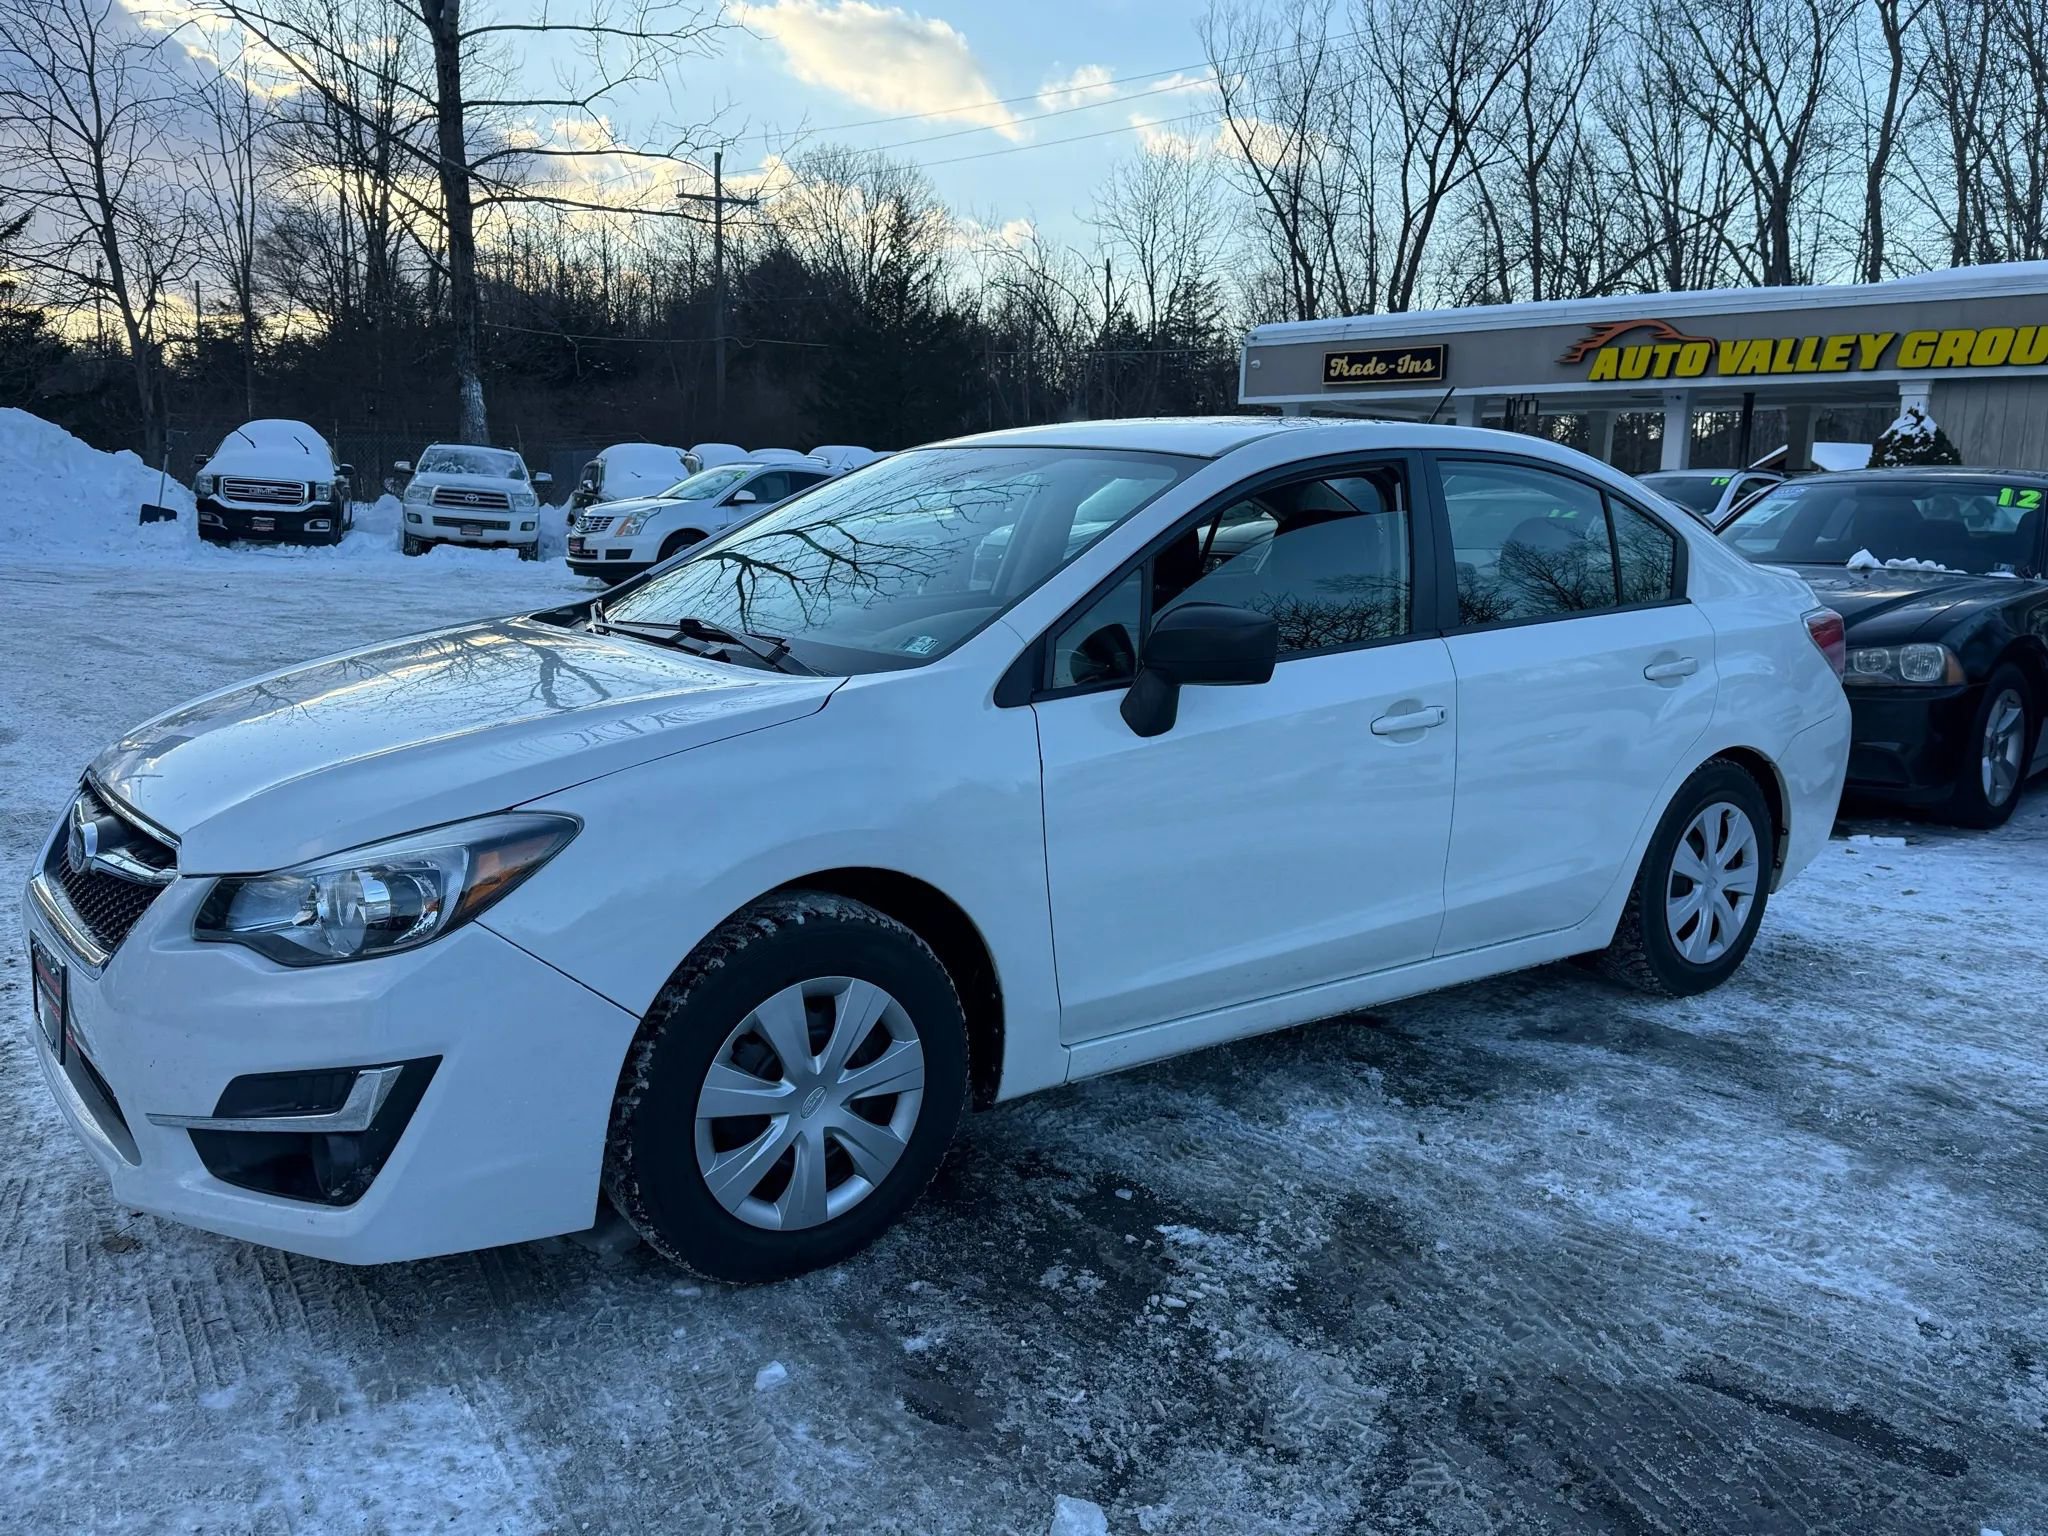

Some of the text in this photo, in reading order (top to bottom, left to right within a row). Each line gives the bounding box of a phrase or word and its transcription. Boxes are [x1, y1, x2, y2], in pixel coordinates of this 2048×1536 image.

[1587, 325, 2048, 381] AUTO VALLEY GROU
[1329, 354, 1436, 377] Trade-Ins
[1997, 487, 2042, 509] 12
